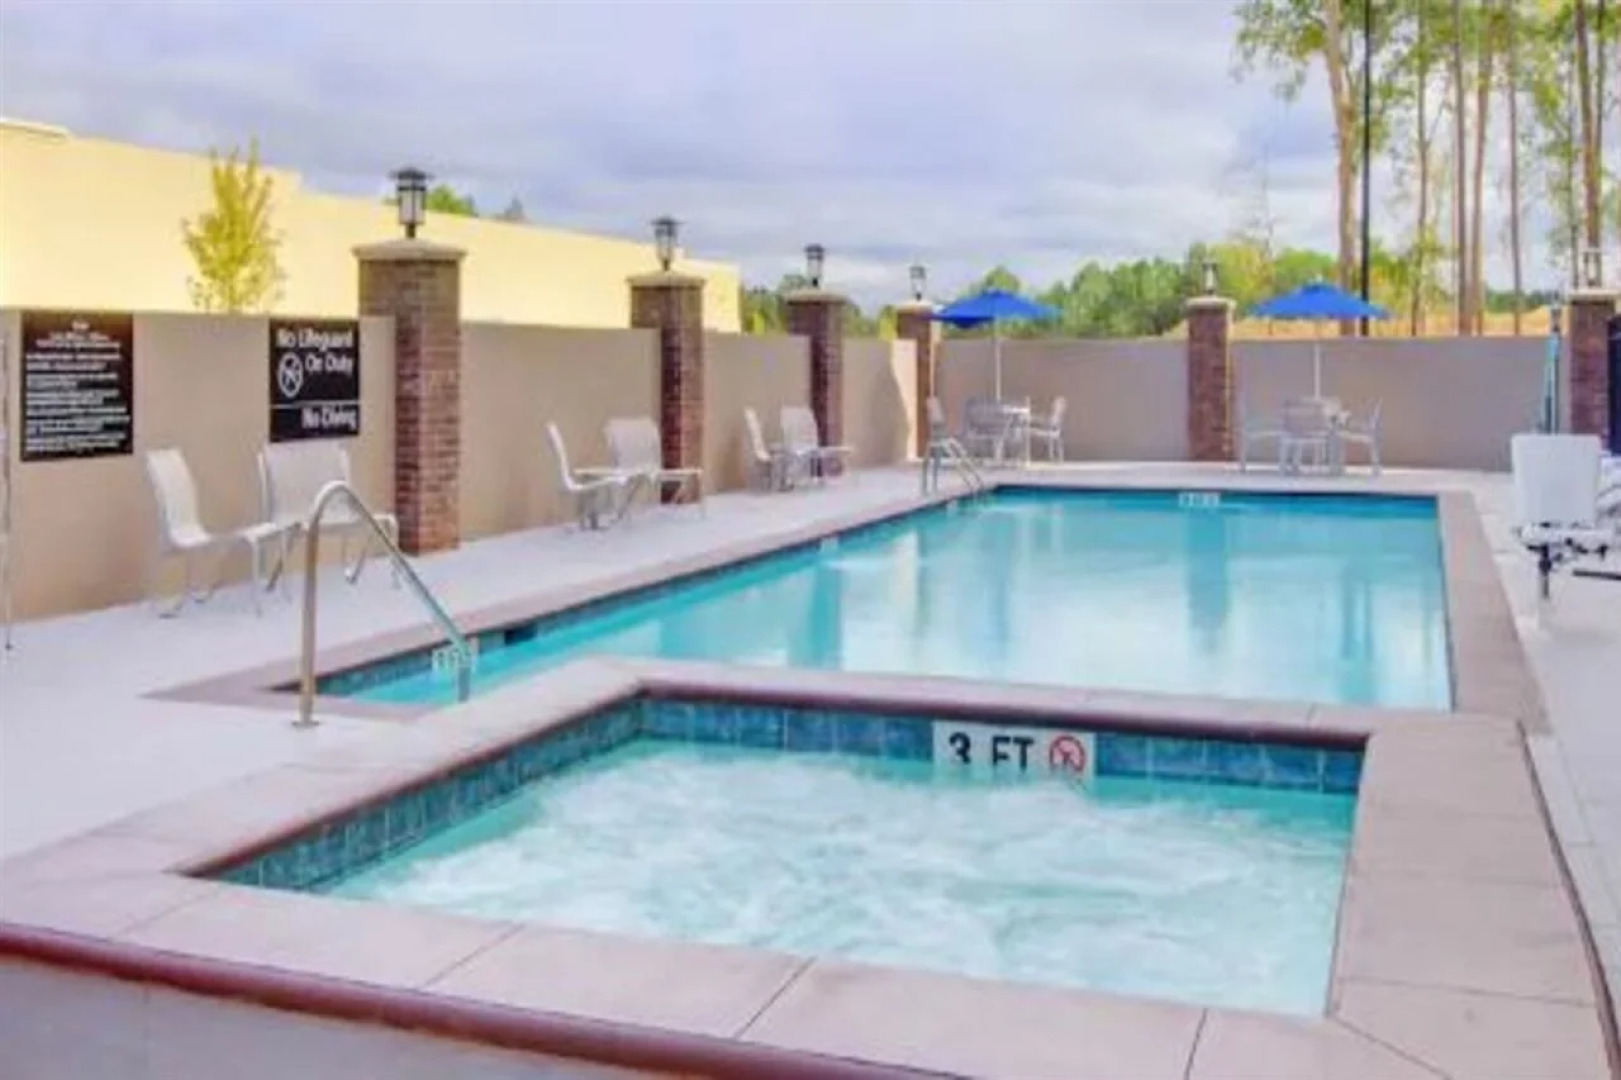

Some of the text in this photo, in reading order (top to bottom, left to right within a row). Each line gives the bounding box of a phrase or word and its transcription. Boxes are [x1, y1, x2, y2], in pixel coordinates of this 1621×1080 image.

[276, 328, 353, 352] No Lifeguard
[305, 352, 353, 376] On Duty
[302, 407, 320, 428] No
[948, 731, 1034, 771] 3 FT
